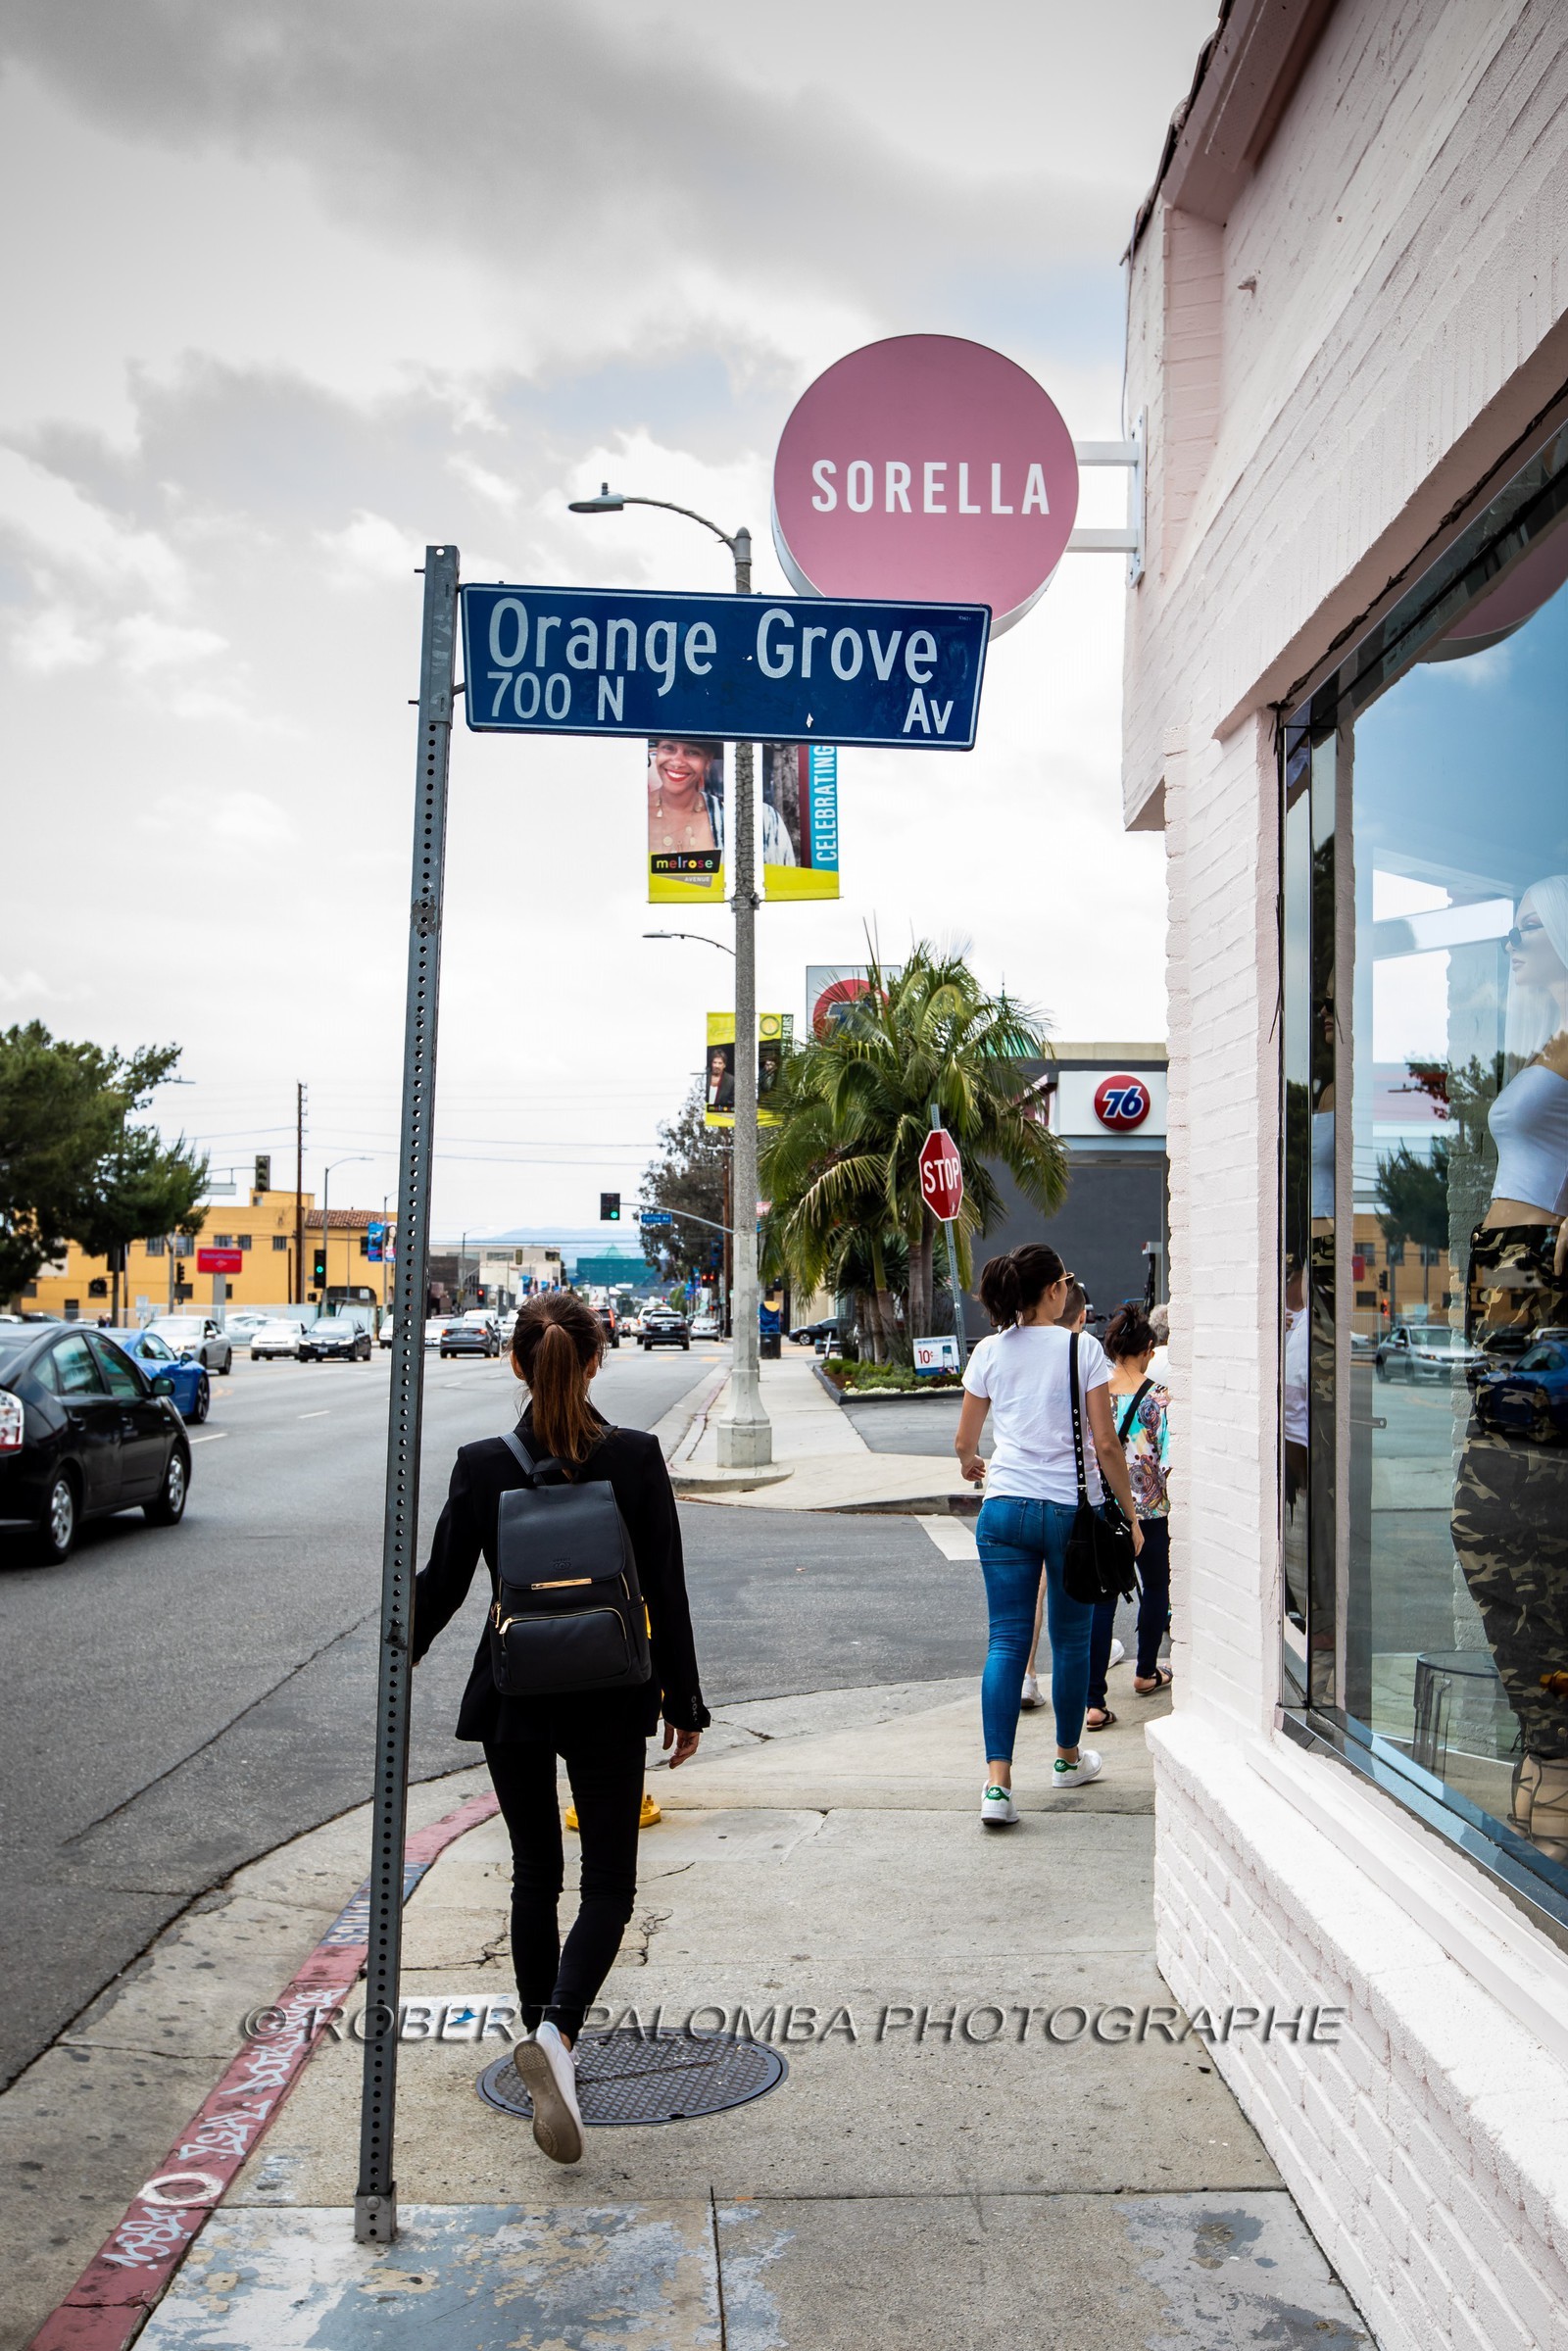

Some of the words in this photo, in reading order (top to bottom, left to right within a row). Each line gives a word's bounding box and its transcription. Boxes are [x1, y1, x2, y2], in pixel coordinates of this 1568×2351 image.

[811, 459, 1051, 514] SORELLA
[489, 597, 716, 697] Orange
[757, 608, 939, 684] Grove
[487, 671, 572, 720] 700
[597, 674, 623, 721] N
[903, 687, 955, 734] Av
[813, 746, 837, 861] CELEBRATING
[657, 856, 713, 868] melrose
[1102, 1086, 1144, 1119] 76
[923, 1157, 960, 1194] STOP
